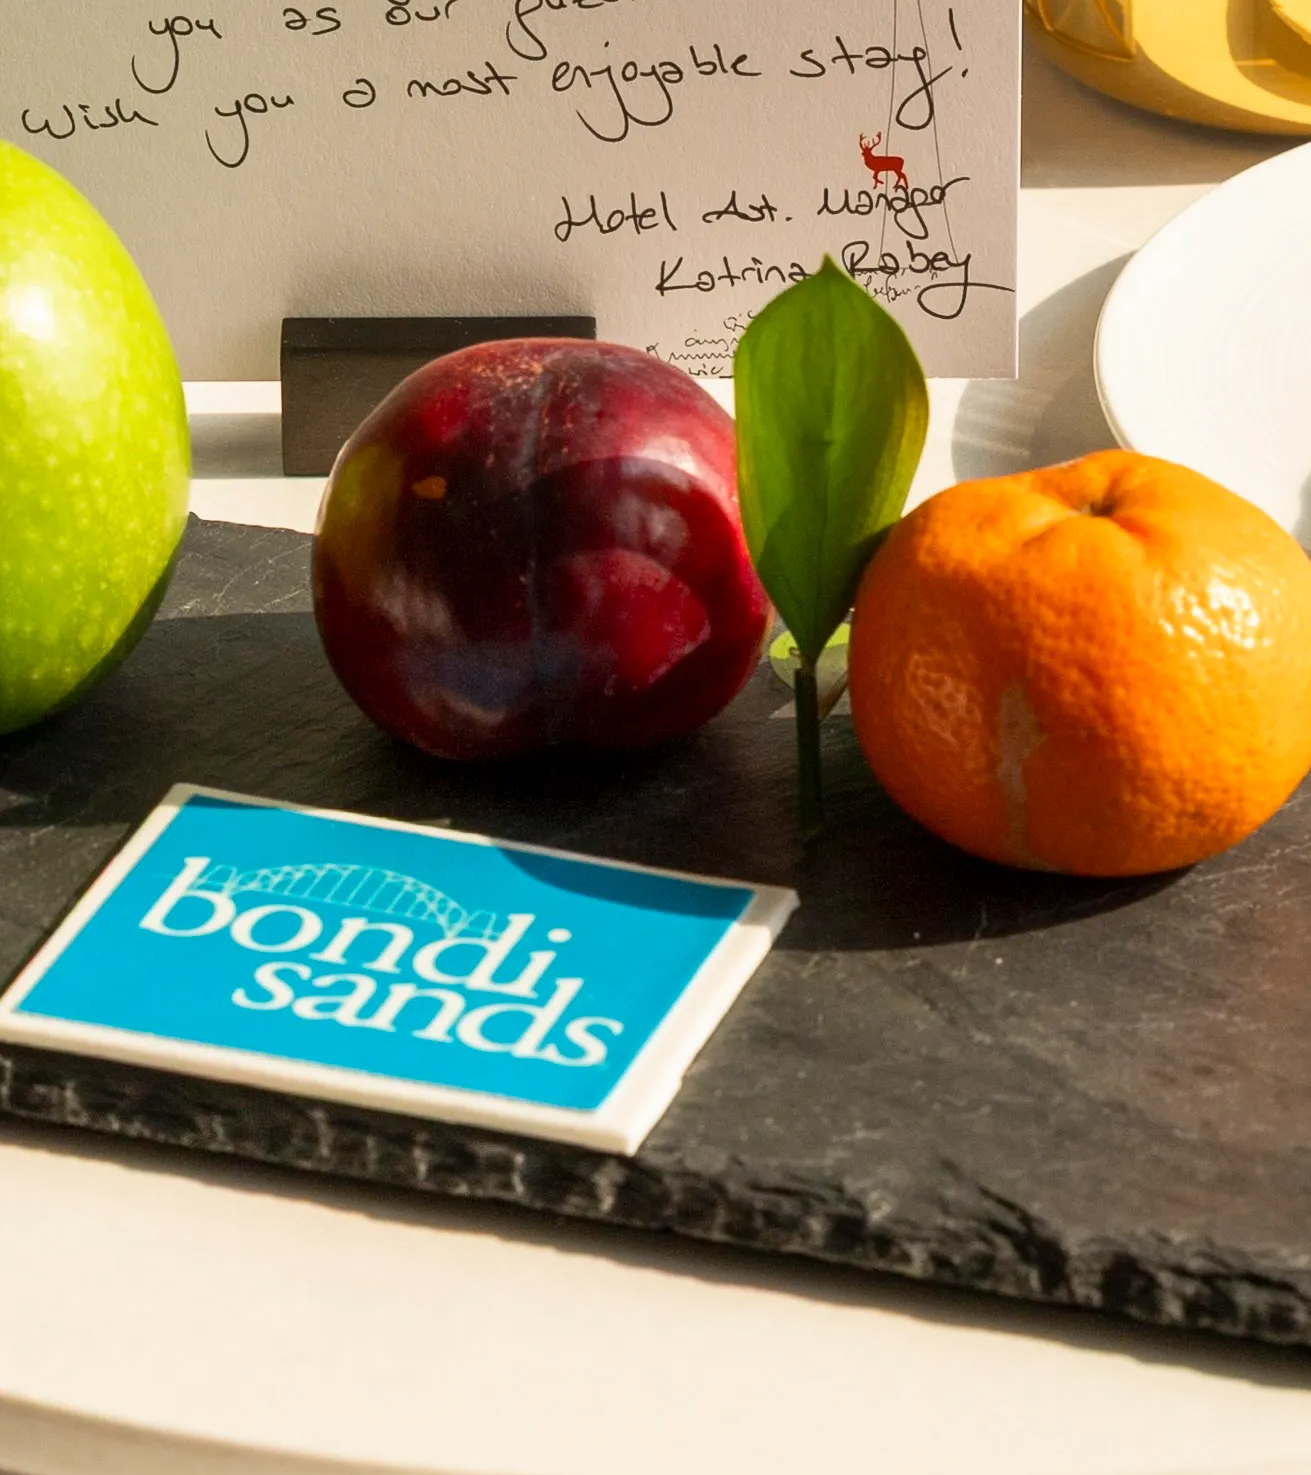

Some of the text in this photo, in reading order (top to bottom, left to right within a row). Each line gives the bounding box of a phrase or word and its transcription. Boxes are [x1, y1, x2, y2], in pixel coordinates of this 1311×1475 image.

[21, 4, 968, 169] Wish you a most enjoyable stay!
[131, 15, 223, 95] you
[282, 6, 342, 36] as
[553, 191, 678, 243] Hotel
[139, 856, 572, 998] bondi
[231, 960, 624, 1067] sands
